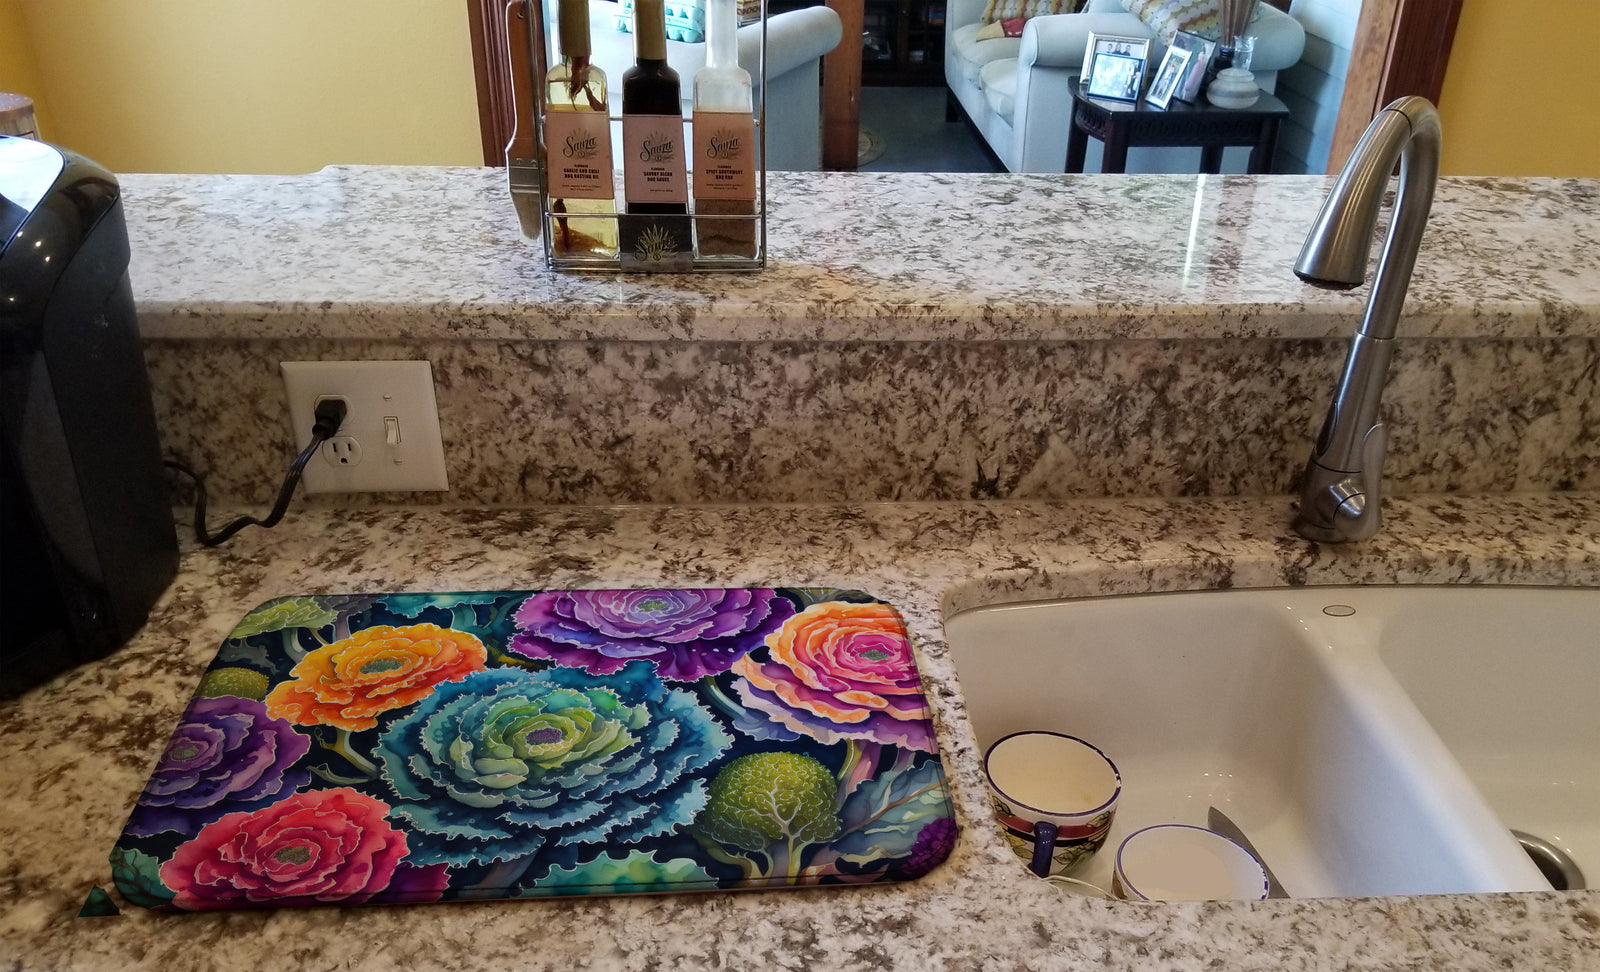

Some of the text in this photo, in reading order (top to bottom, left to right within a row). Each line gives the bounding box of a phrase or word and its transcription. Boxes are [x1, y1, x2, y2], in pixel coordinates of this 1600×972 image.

[562, 136, 597, 158] Sauza
[639, 139, 674, 162] Sauza
[706, 137, 740, 159] Sauza
